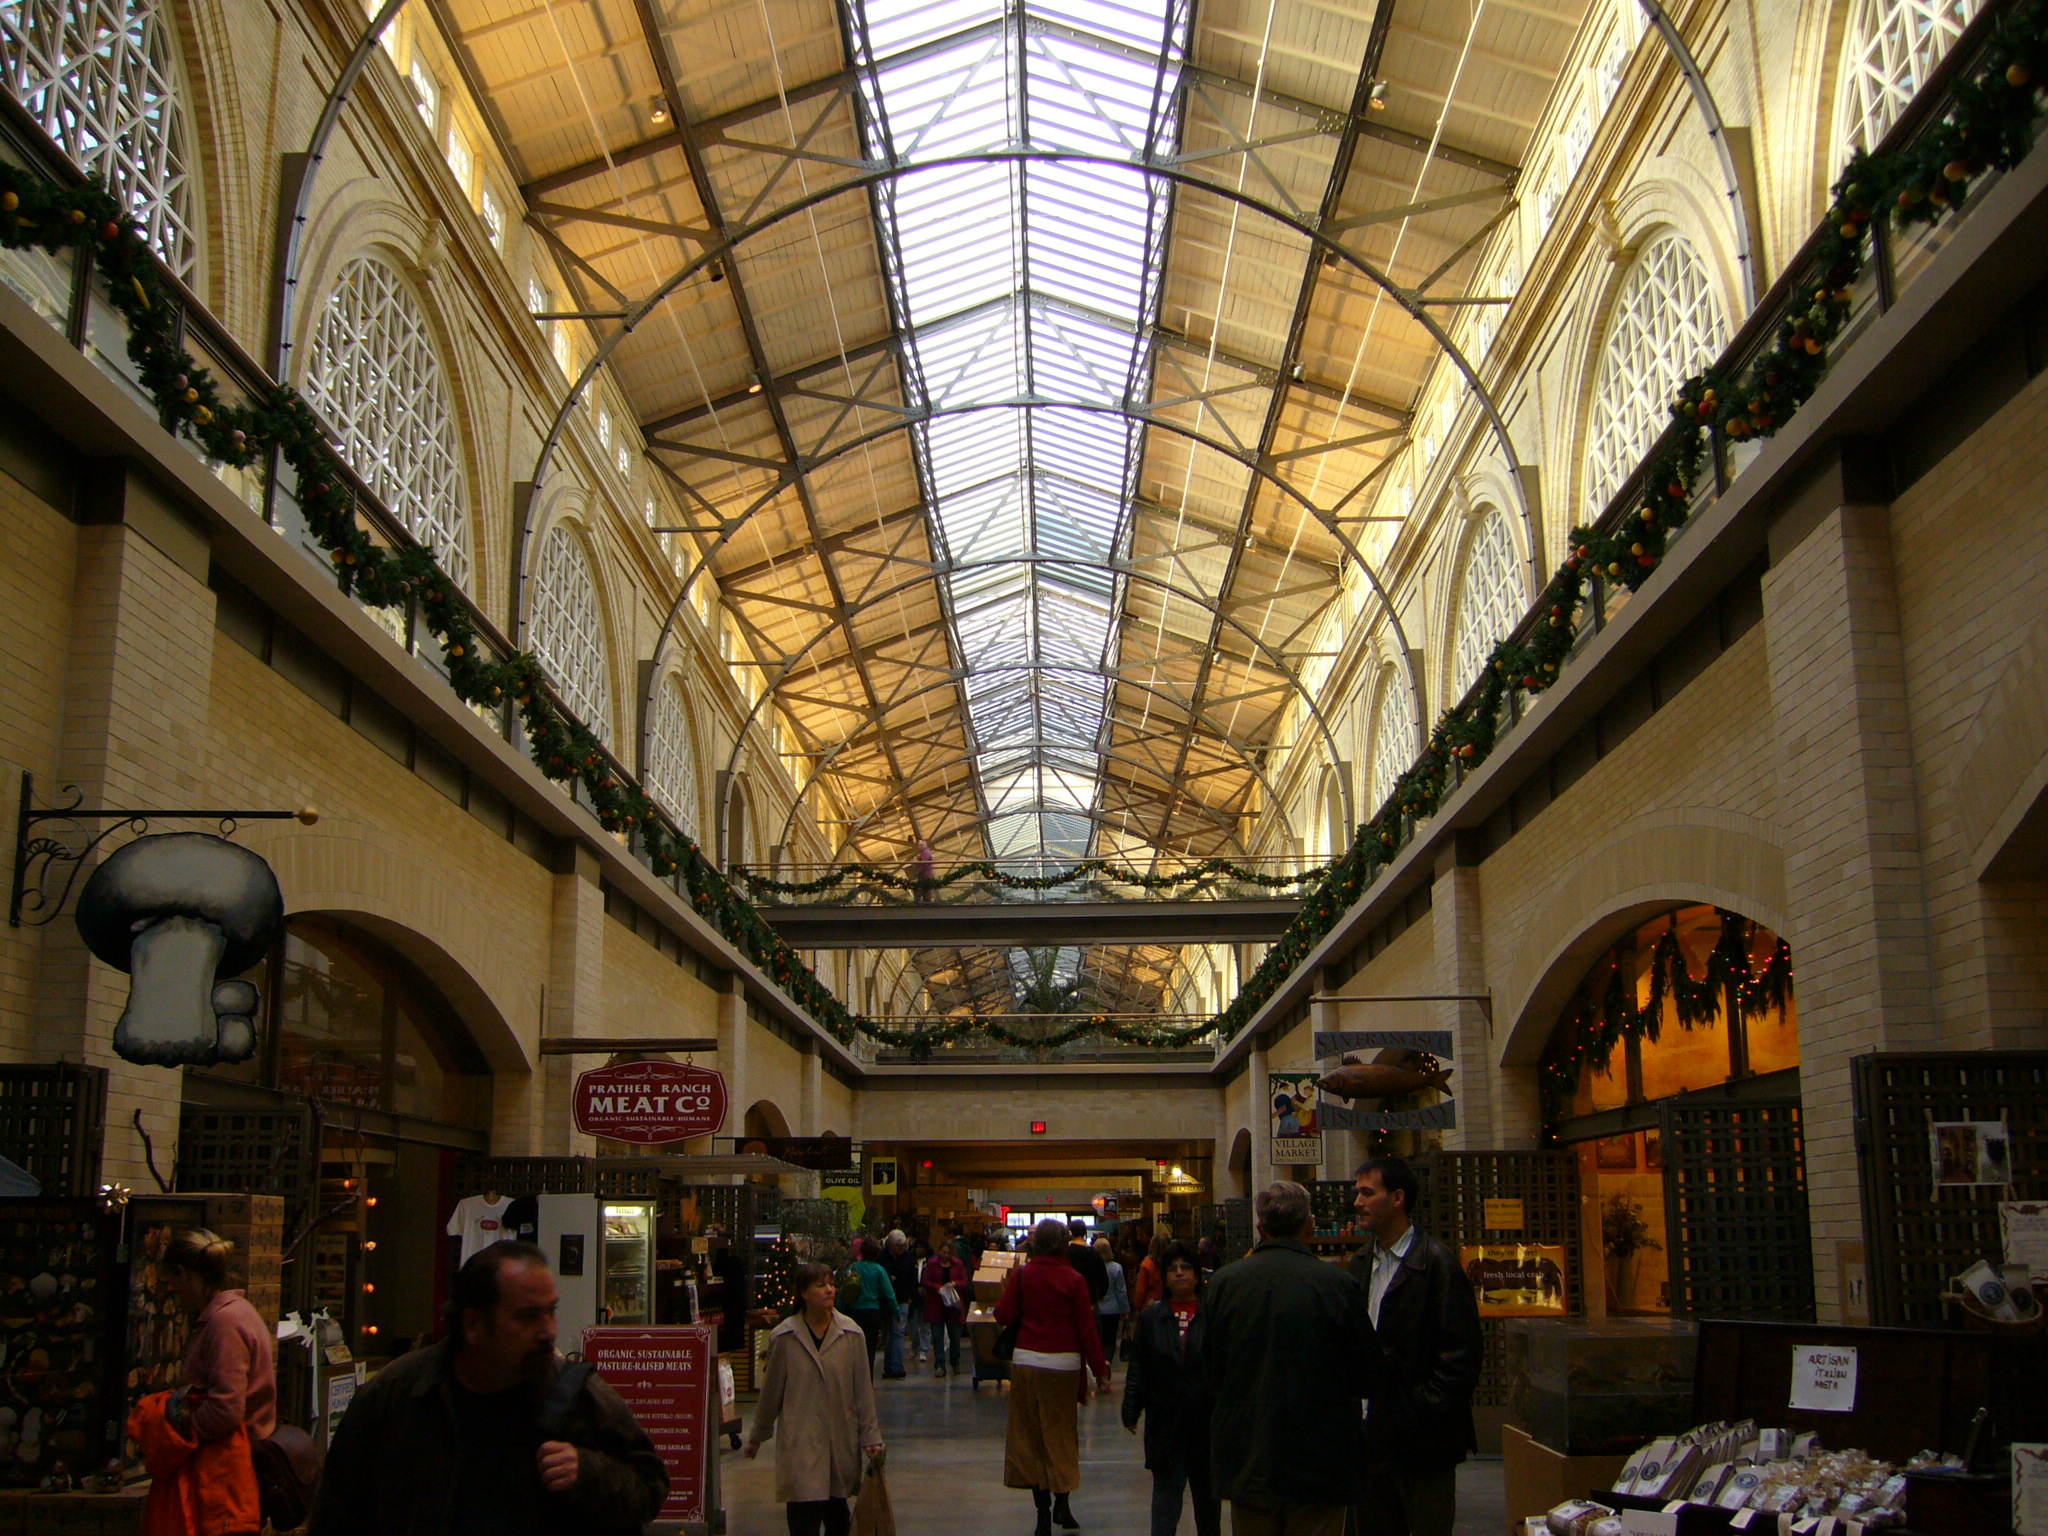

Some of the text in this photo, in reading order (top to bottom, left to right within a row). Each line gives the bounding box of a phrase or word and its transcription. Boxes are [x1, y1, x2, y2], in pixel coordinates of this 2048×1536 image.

[1317, 1032, 1451, 1055] SAN FRANCISCO
[588, 1084, 711, 1094] PRATHER RANCH
[588, 1096, 670, 1114] MEAT
[1321, 1104, 1450, 1129] FISH COMPANY
[1275, 1140, 1317, 1149] VILLAGE
[1275, 1149, 1317, 1158] MARKET
[1487, 1249, 1515, 1257] they're
[1483, 1271, 1544, 1279] fresh local crab
[597, 1348, 693, 1360] ORGANIC, SUSTAINABLE,
[597, 1361, 692, 1371] PASTURE-RAISED MEATS
